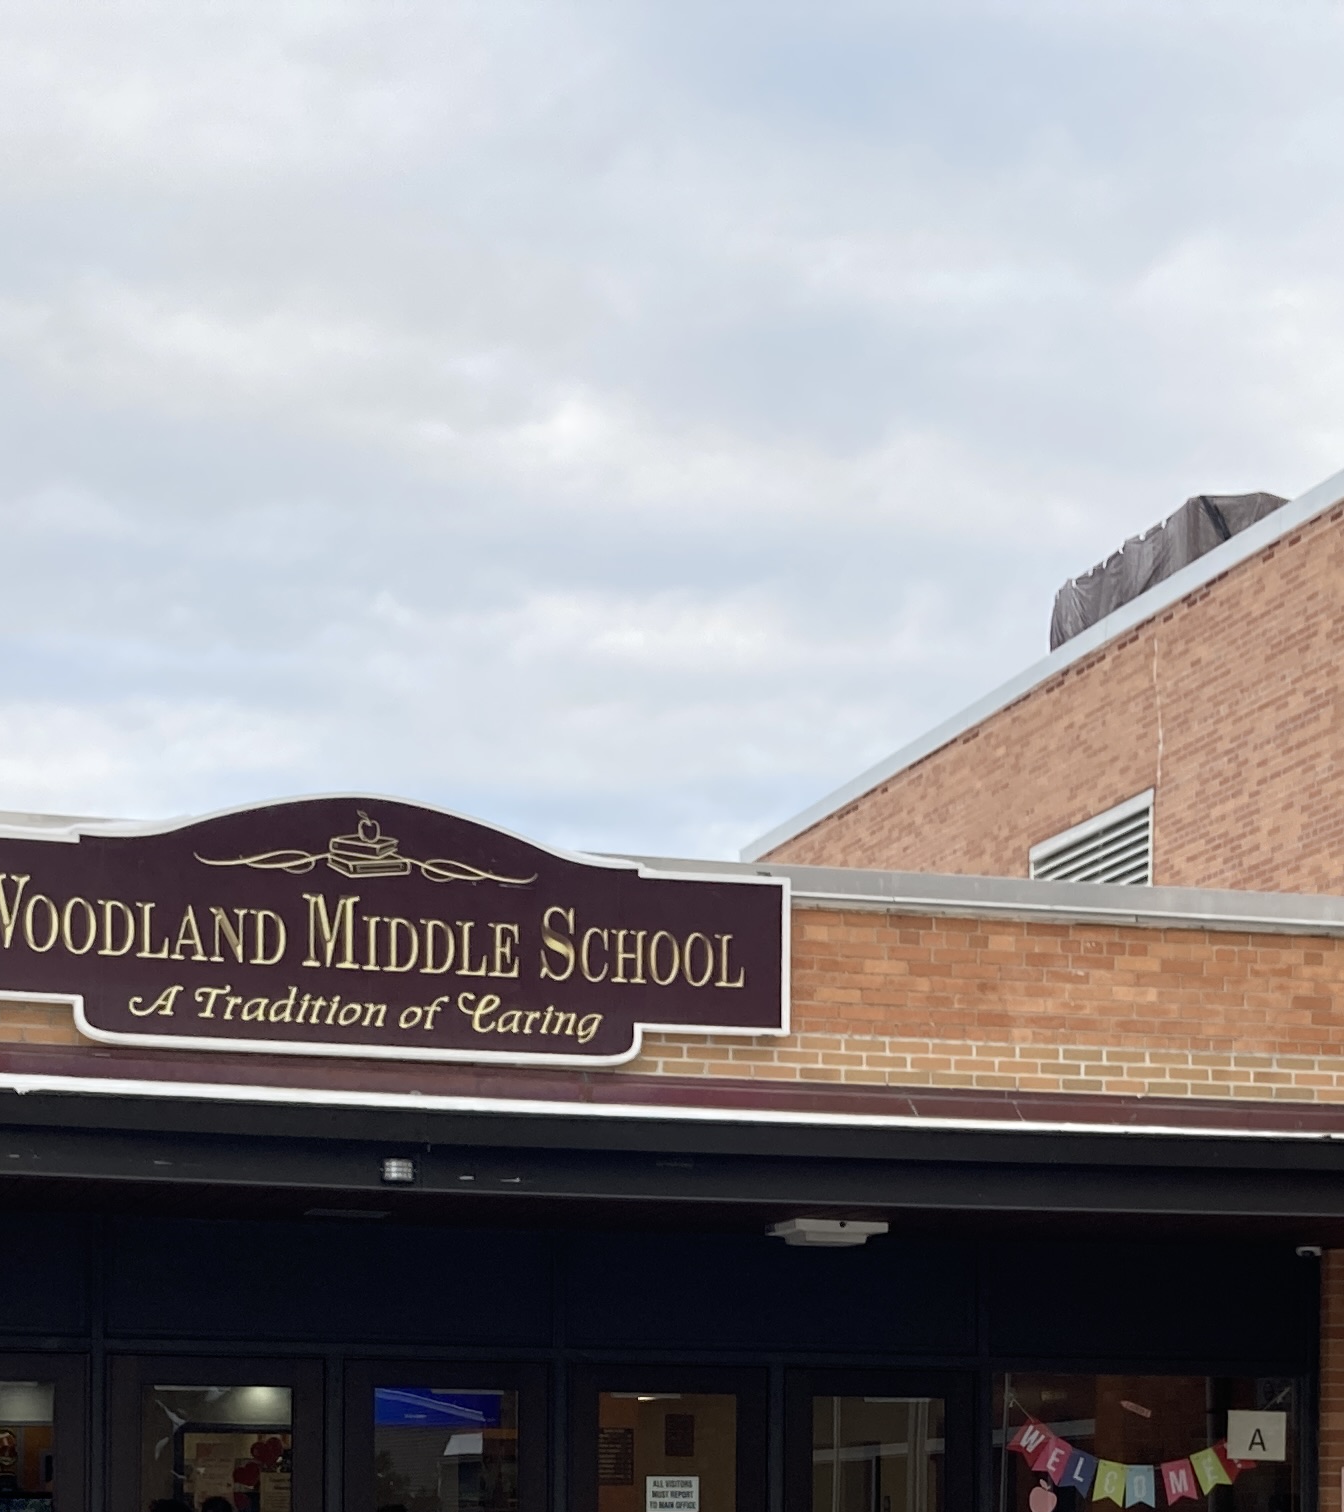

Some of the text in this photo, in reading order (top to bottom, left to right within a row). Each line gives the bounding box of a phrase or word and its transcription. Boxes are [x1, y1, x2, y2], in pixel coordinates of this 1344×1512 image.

[302, 893, 521, 979] MIDDLE
[540, 906, 745, 988] SCHOOL
[128, 984, 604, 1044] A Tradition of Caring
[1248, 1428, 1267, 1452] A
[1019, 1424, 1218, 1499] WELCOME
[652, 1490, 694, 1499] MUST REPORT
[665, 1480, 693, 1488] VISITORS
[649, 1501, 696, 1509] TO MAIN OFFICE
